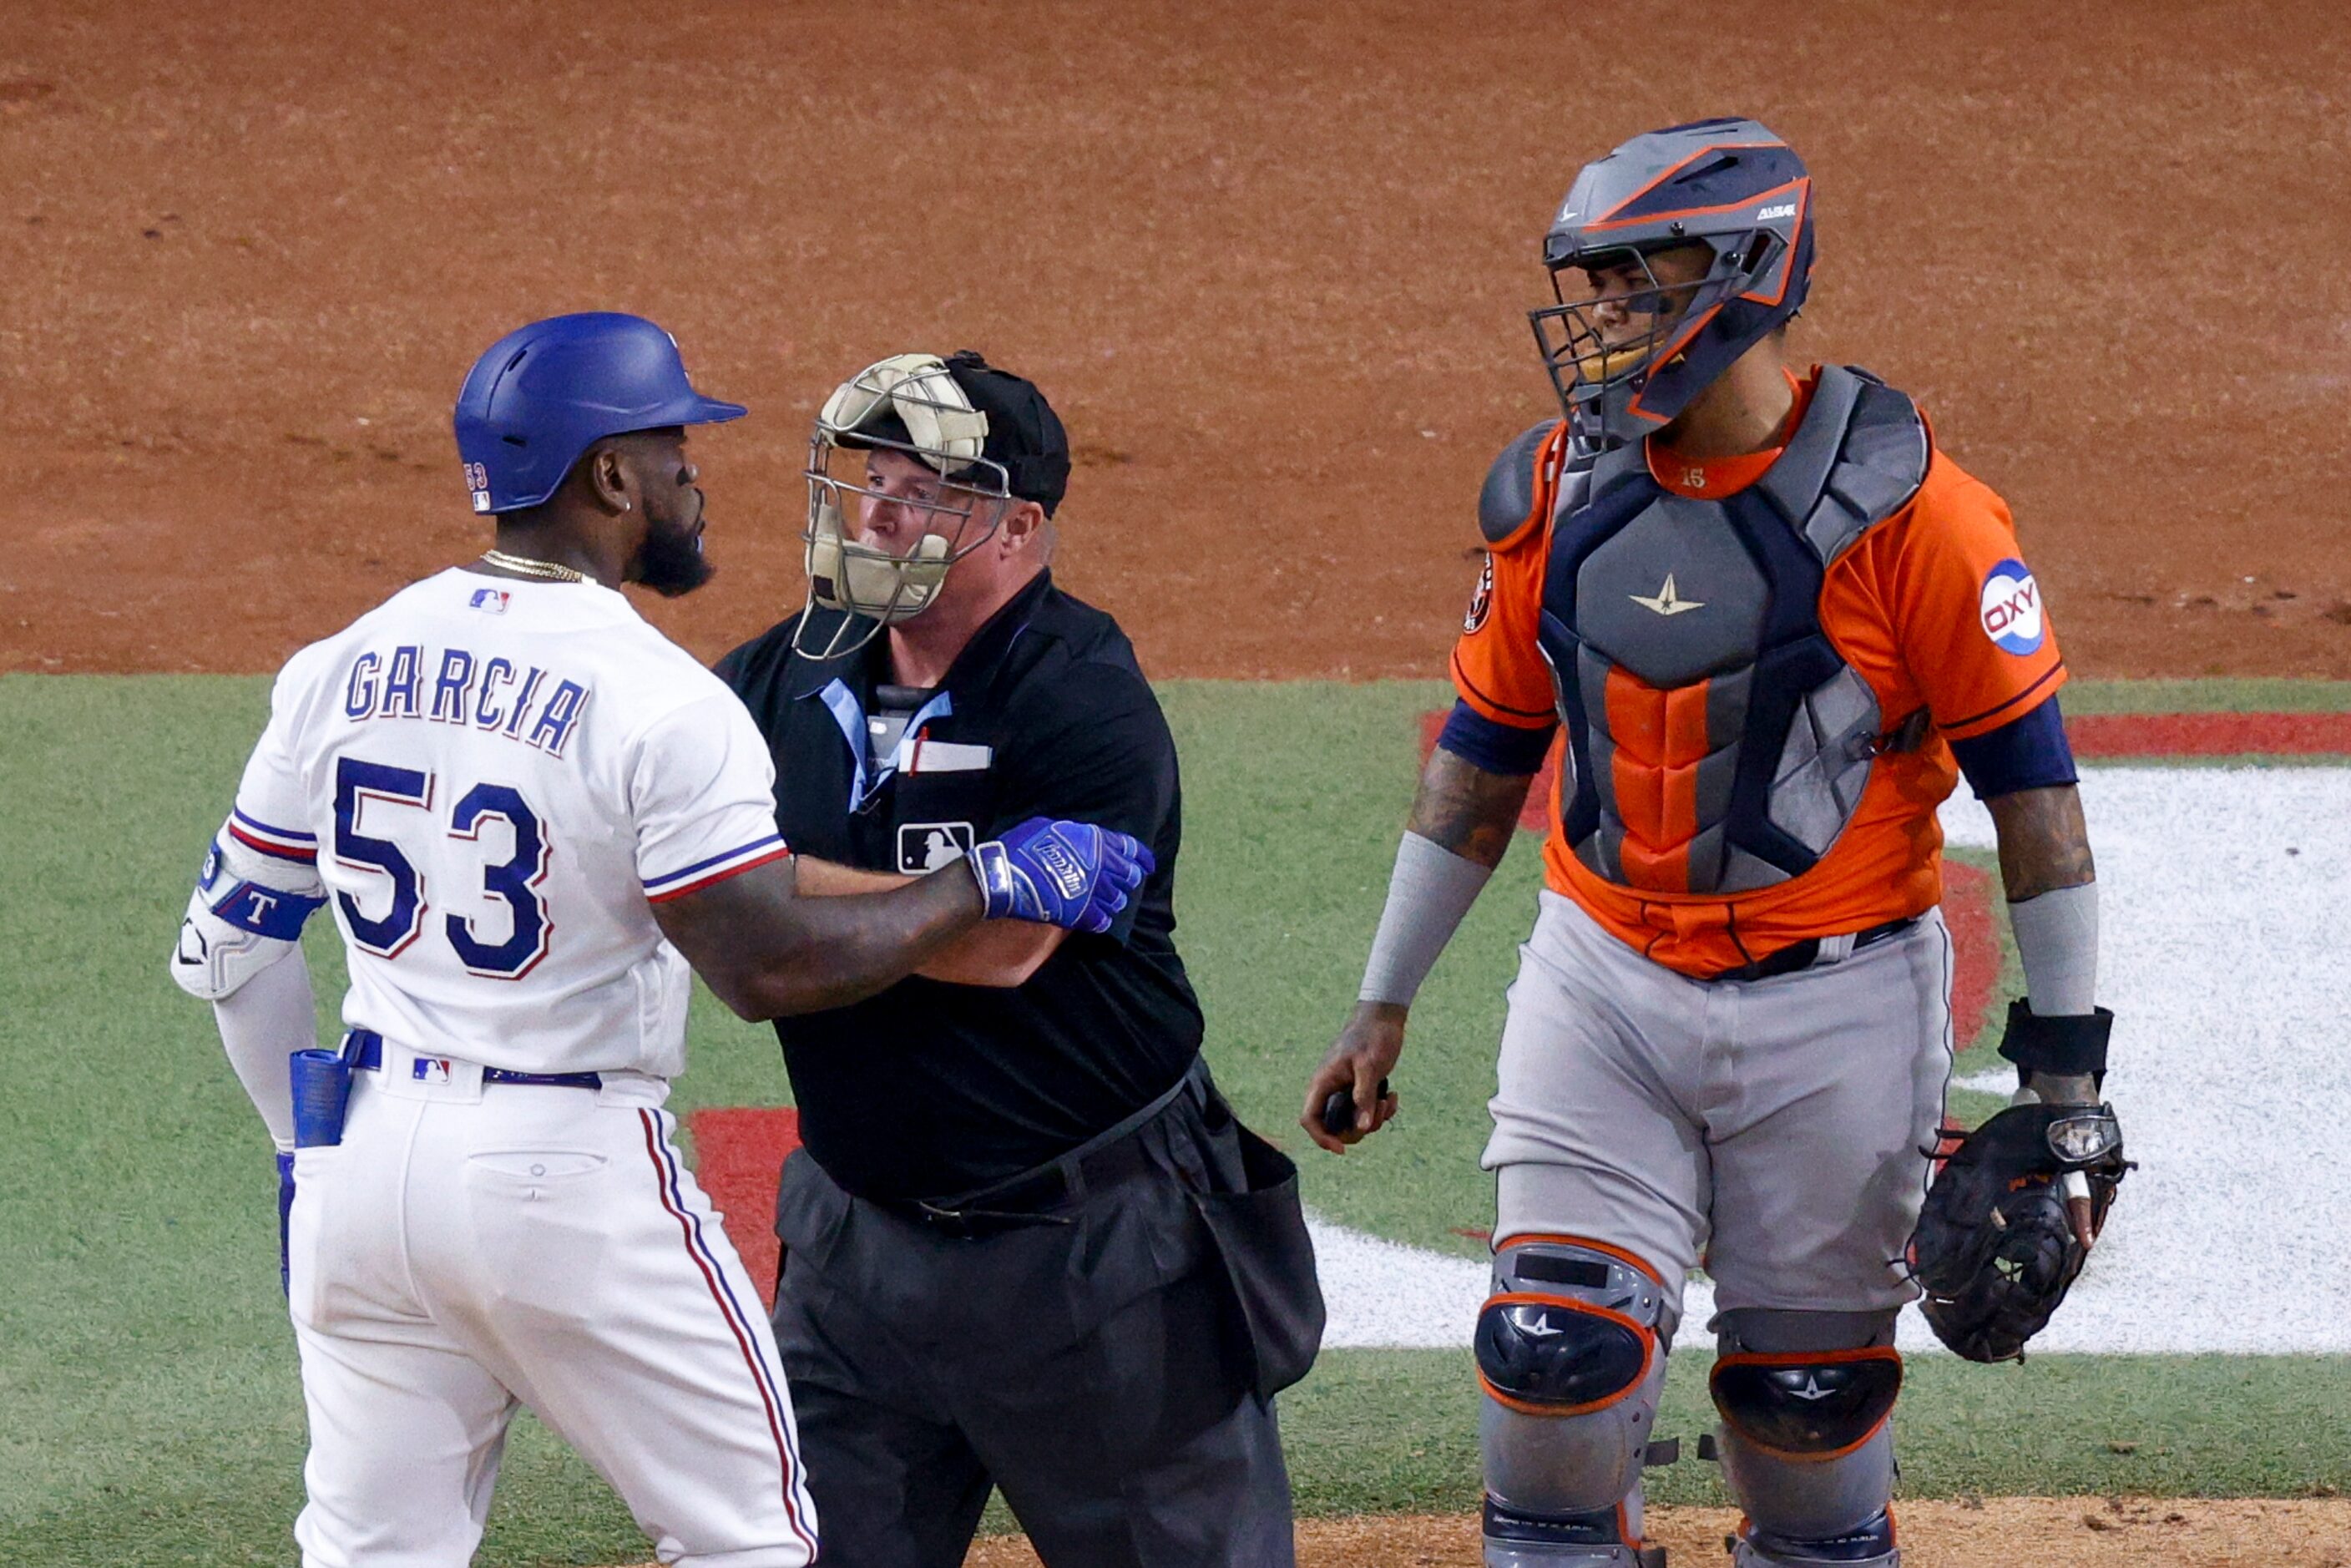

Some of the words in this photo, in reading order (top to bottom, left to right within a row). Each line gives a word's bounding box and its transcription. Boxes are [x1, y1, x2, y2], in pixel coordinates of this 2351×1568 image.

[463, 462, 488, 491] 53
[1680, 467, 1706, 488] 15
[1984, 581, 2034, 633] OXY
[345, 644, 590, 760] GARCIA
[333, 756, 555, 981] 53
[247, 890, 277, 925] T
